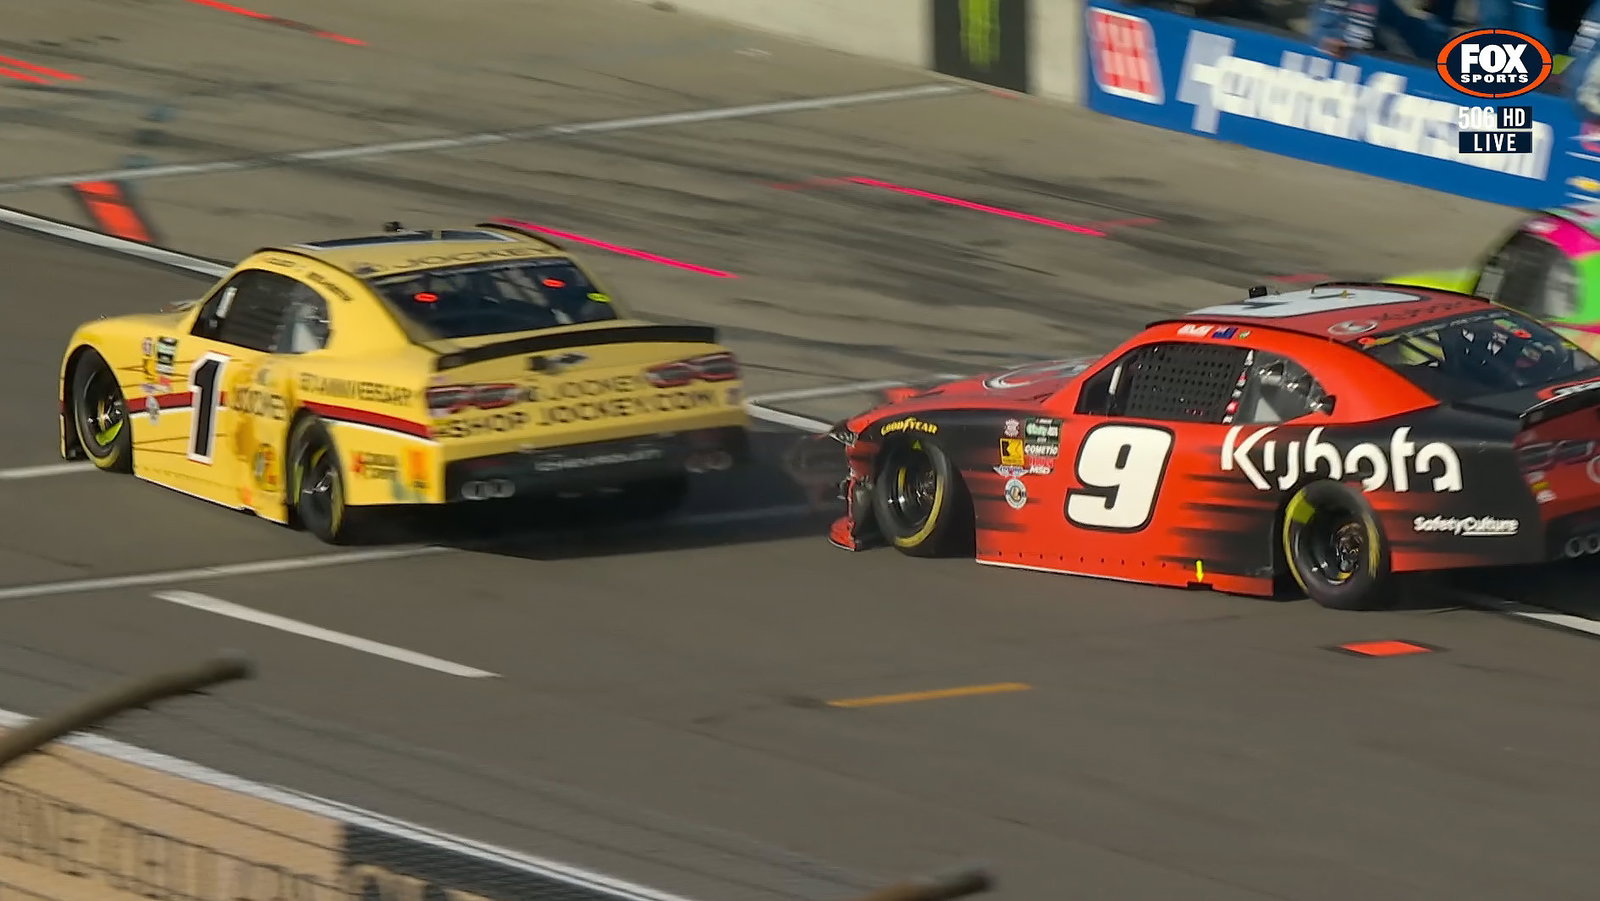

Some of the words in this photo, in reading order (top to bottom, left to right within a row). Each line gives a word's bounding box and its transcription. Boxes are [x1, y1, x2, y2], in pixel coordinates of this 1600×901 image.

[189, 352, 230, 464] 1
[880, 416, 938, 436] GOODYEAR
[1065, 422, 1175, 532] 9
[1220, 425, 1464, 493] Kubota
[1413, 514, 1519, 536] SafetyCulture
